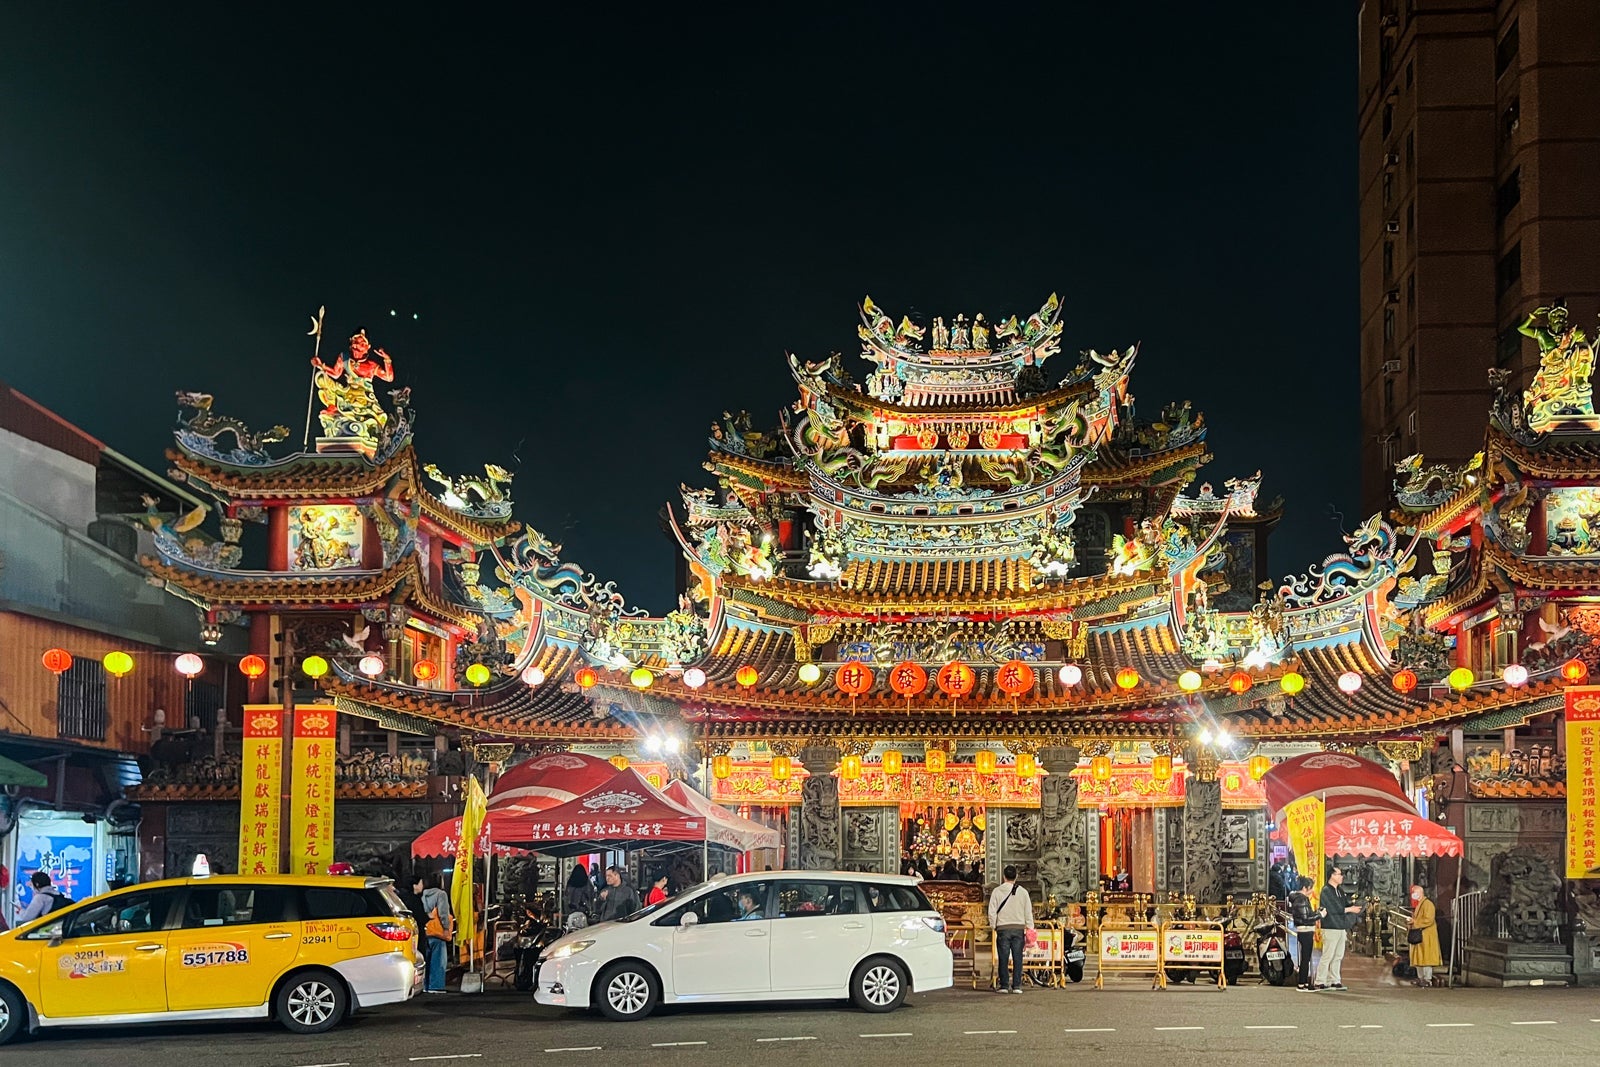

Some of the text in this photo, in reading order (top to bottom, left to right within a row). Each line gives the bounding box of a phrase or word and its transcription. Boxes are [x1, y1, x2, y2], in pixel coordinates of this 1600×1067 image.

[843, 668, 1022, 689] 恭 禧 發 財
[554, 822, 663, 836] 台北市松山慈祐宮
[1367, 819, 1413, 834] 台北市
[1337, 834, 1429, 851] 松山慈祐宮
[302, 935, 332, 944] 32941
[1120, 941, 1154, 953] 請勿停車
[1184, 941, 1218, 953] 請勿停車
[74, 950, 104, 960] 32941
[183, 950, 248, 966] 551788
